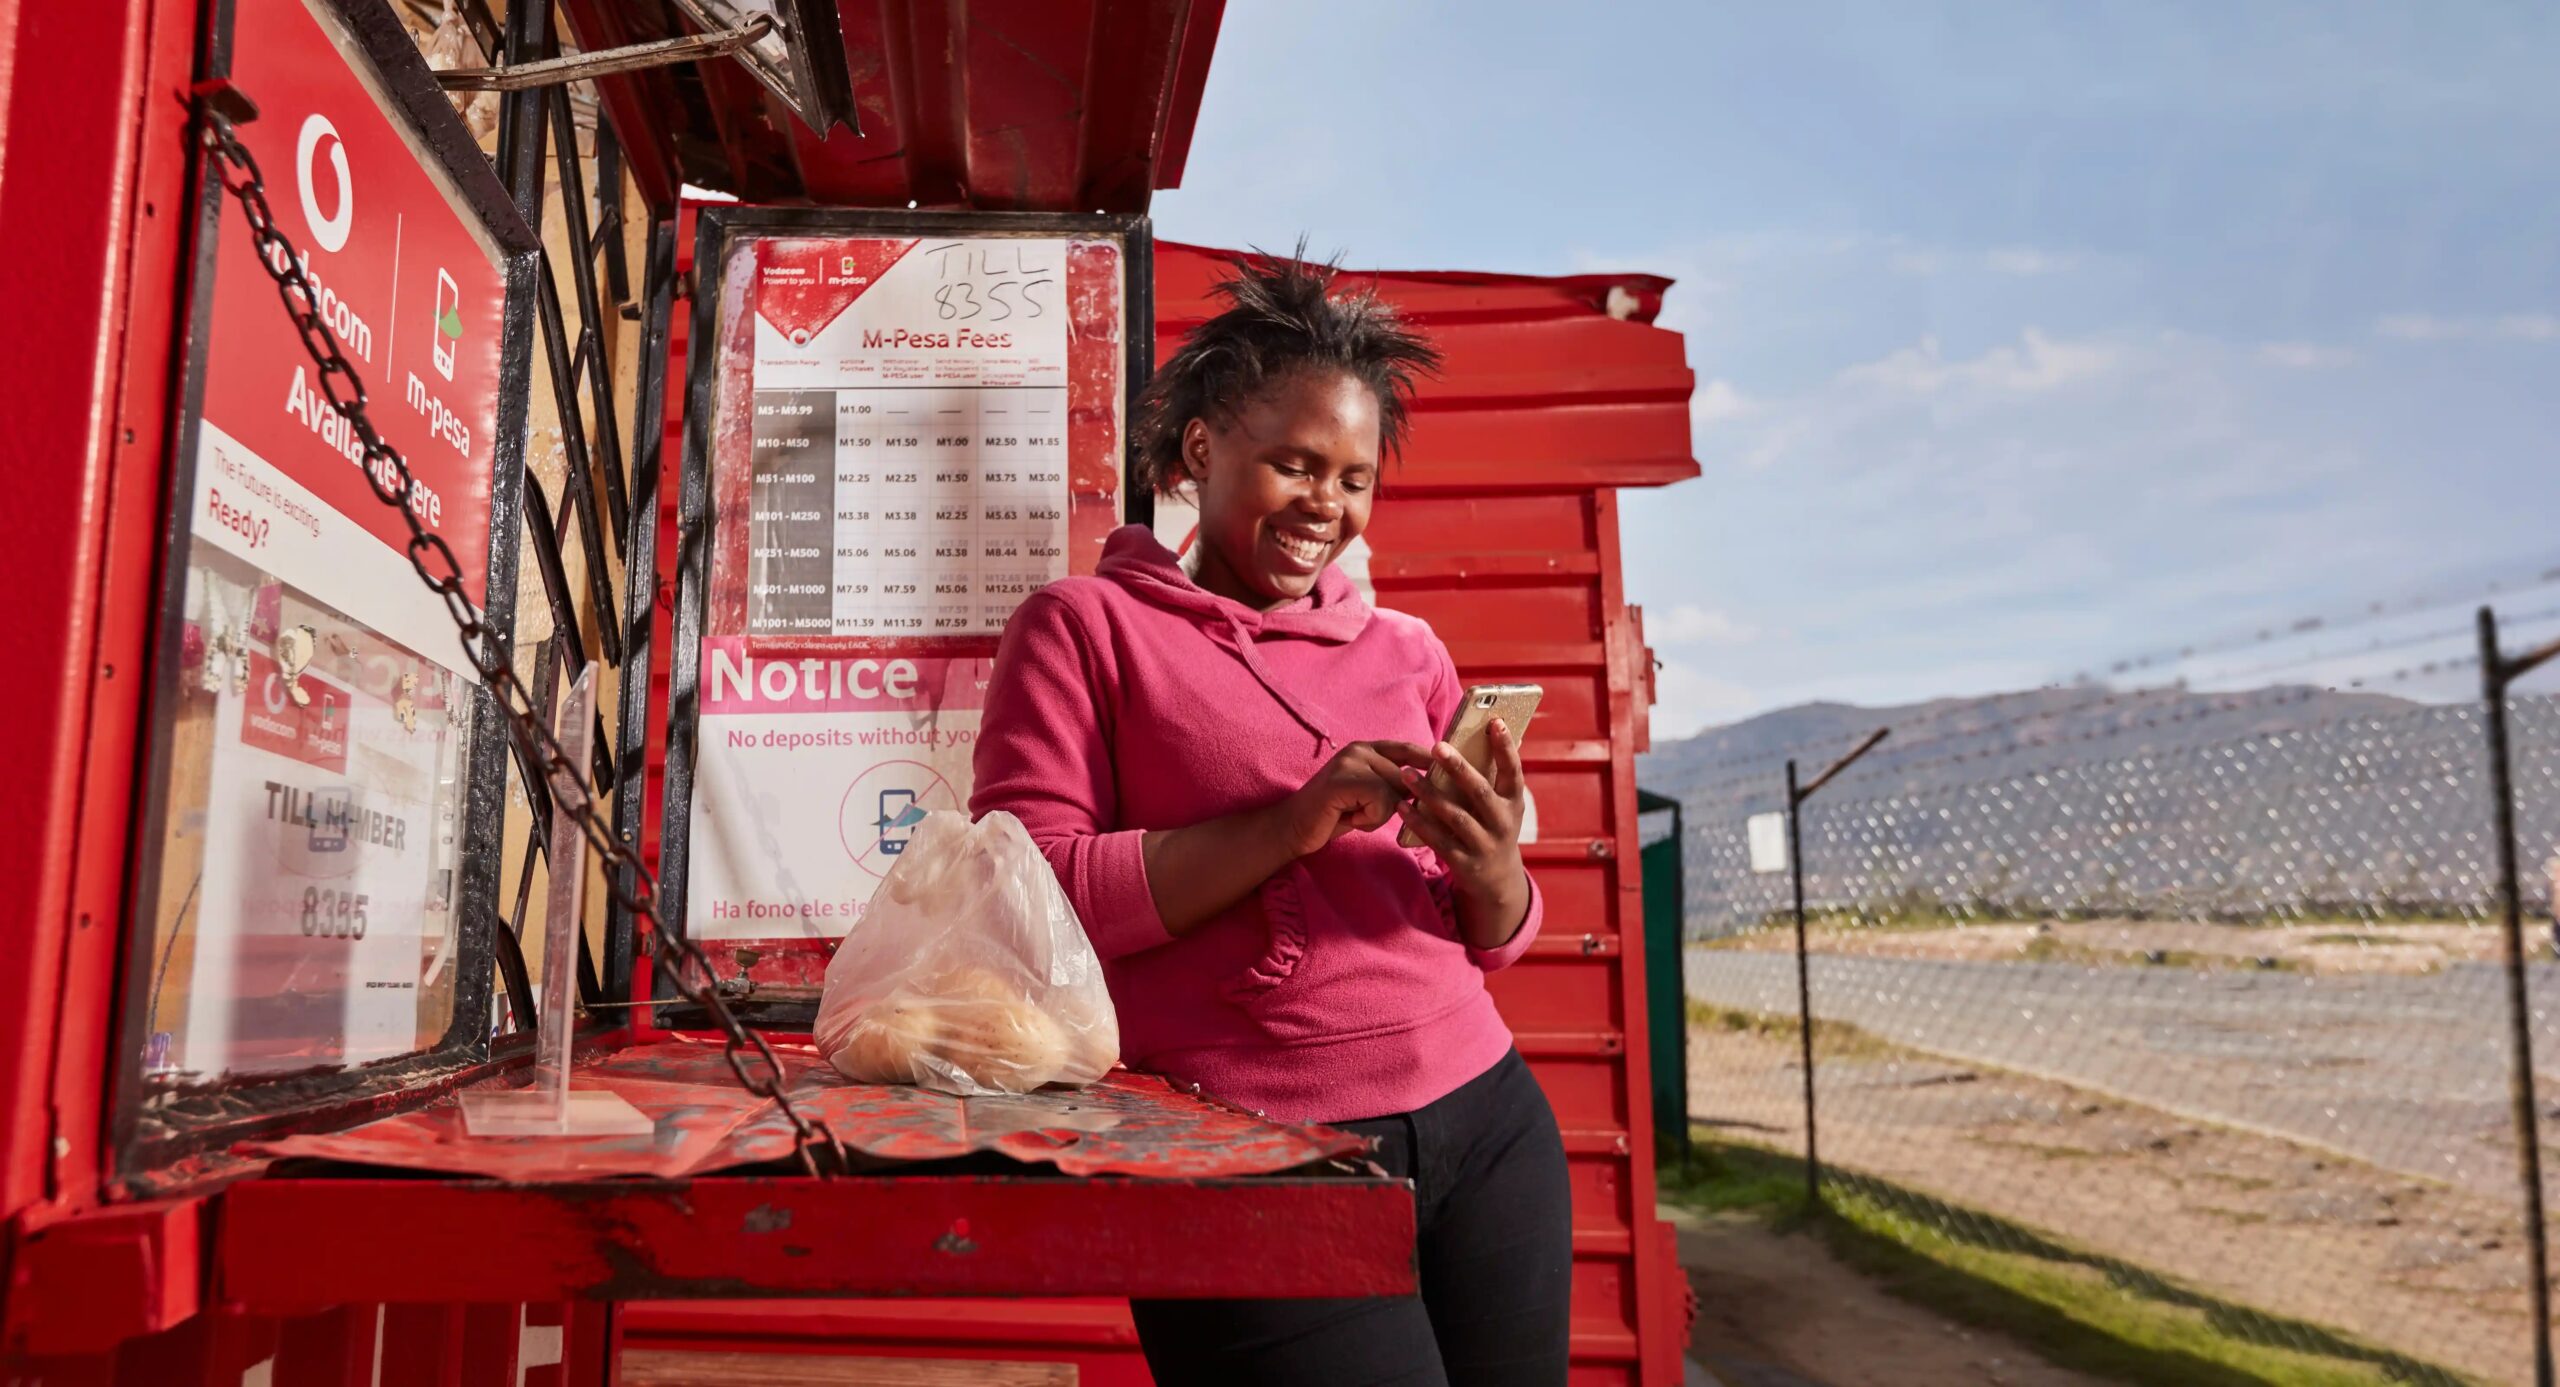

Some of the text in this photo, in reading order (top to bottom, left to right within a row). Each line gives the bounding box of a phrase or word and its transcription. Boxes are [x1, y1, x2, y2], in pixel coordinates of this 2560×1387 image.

[925, 243, 1049, 279] TILL
[763, 277, 815, 287] Power to you
[828, 276, 867, 287] m-pesa
[262, 239, 371, 363] odacom
[934, 279, 1054, 321] 8355
[863, 328, 1013, 349] M-Pesa Fees
[407, 371, 470, 458] m-pesa
[757, 405, 773, 415] M5
[780, 405, 813, 415] M9.99
[840, 405, 871, 414] M1.00
[757, 438, 780, 448] M10
[786, 438, 809, 448] M50
[839, 438, 871, 446] M1.50
[886, 438, 917, 446] M1.50
[937, 438, 969, 446] M1.00
[985, 438, 1017, 446] M2.50
[1028, 438, 1059, 446] M1.85
[215, 446, 236, 480] The
[238, 463, 272, 503] Future
[274, 486, 282, 509] is
[756, 474, 778, 483] M51
[785, 474, 815, 483] M100
[838, 474, 870, 482] M2.25
[885, 474, 917, 482] M2.25
[936, 474, 968, 482] M1.50
[985, 474, 1017, 482] M3.75
[1029, 474, 1060, 482] M3.00
[208, 487, 270, 549] Ready?
[791, 511, 820, 521] M250
[838, 512, 869, 520] M3.38
[885, 512, 916, 520] M3.38
[936, 511, 968, 520] M2.25
[985, 511, 1017, 520] M5.63
[1029, 511, 1060, 520] M4.50
[790, 548, 820, 557] M500
[837, 549, 869, 557] M5.06
[884, 549, 916, 557] M5.06
[935, 548, 968, 557] M3.38
[985, 548, 1017, 557] M8.44
[1029, 548, 1060, 557] M6.00
[789, 584, 825, 594] M1000
[836, 585, 868, 594] M7.59
[884, 585, 916, 593] M7.59
[935, 585, 967, 593] M5.06
[985, 585, 1024, 593] M12.65
[795, 618, 831, 628] M5000
[836, 619, 874, 627] M11.39
[883, 619, 922, 627] M11.39
[935, 618, 967, 627] M7.59
[711, 648, 919, 702] Notice
[728, 730, 756, 748] No
[762, 729, 853, 751] deposits
[858, 727, 941, 746] without
[265, 781, 317, 829] TILL
[301, 886, 369, 941] 8355
[713, 900, 740, 918] Ha
[747, 899, 796, 918] fono
[801, 900, 834, 918] ele
